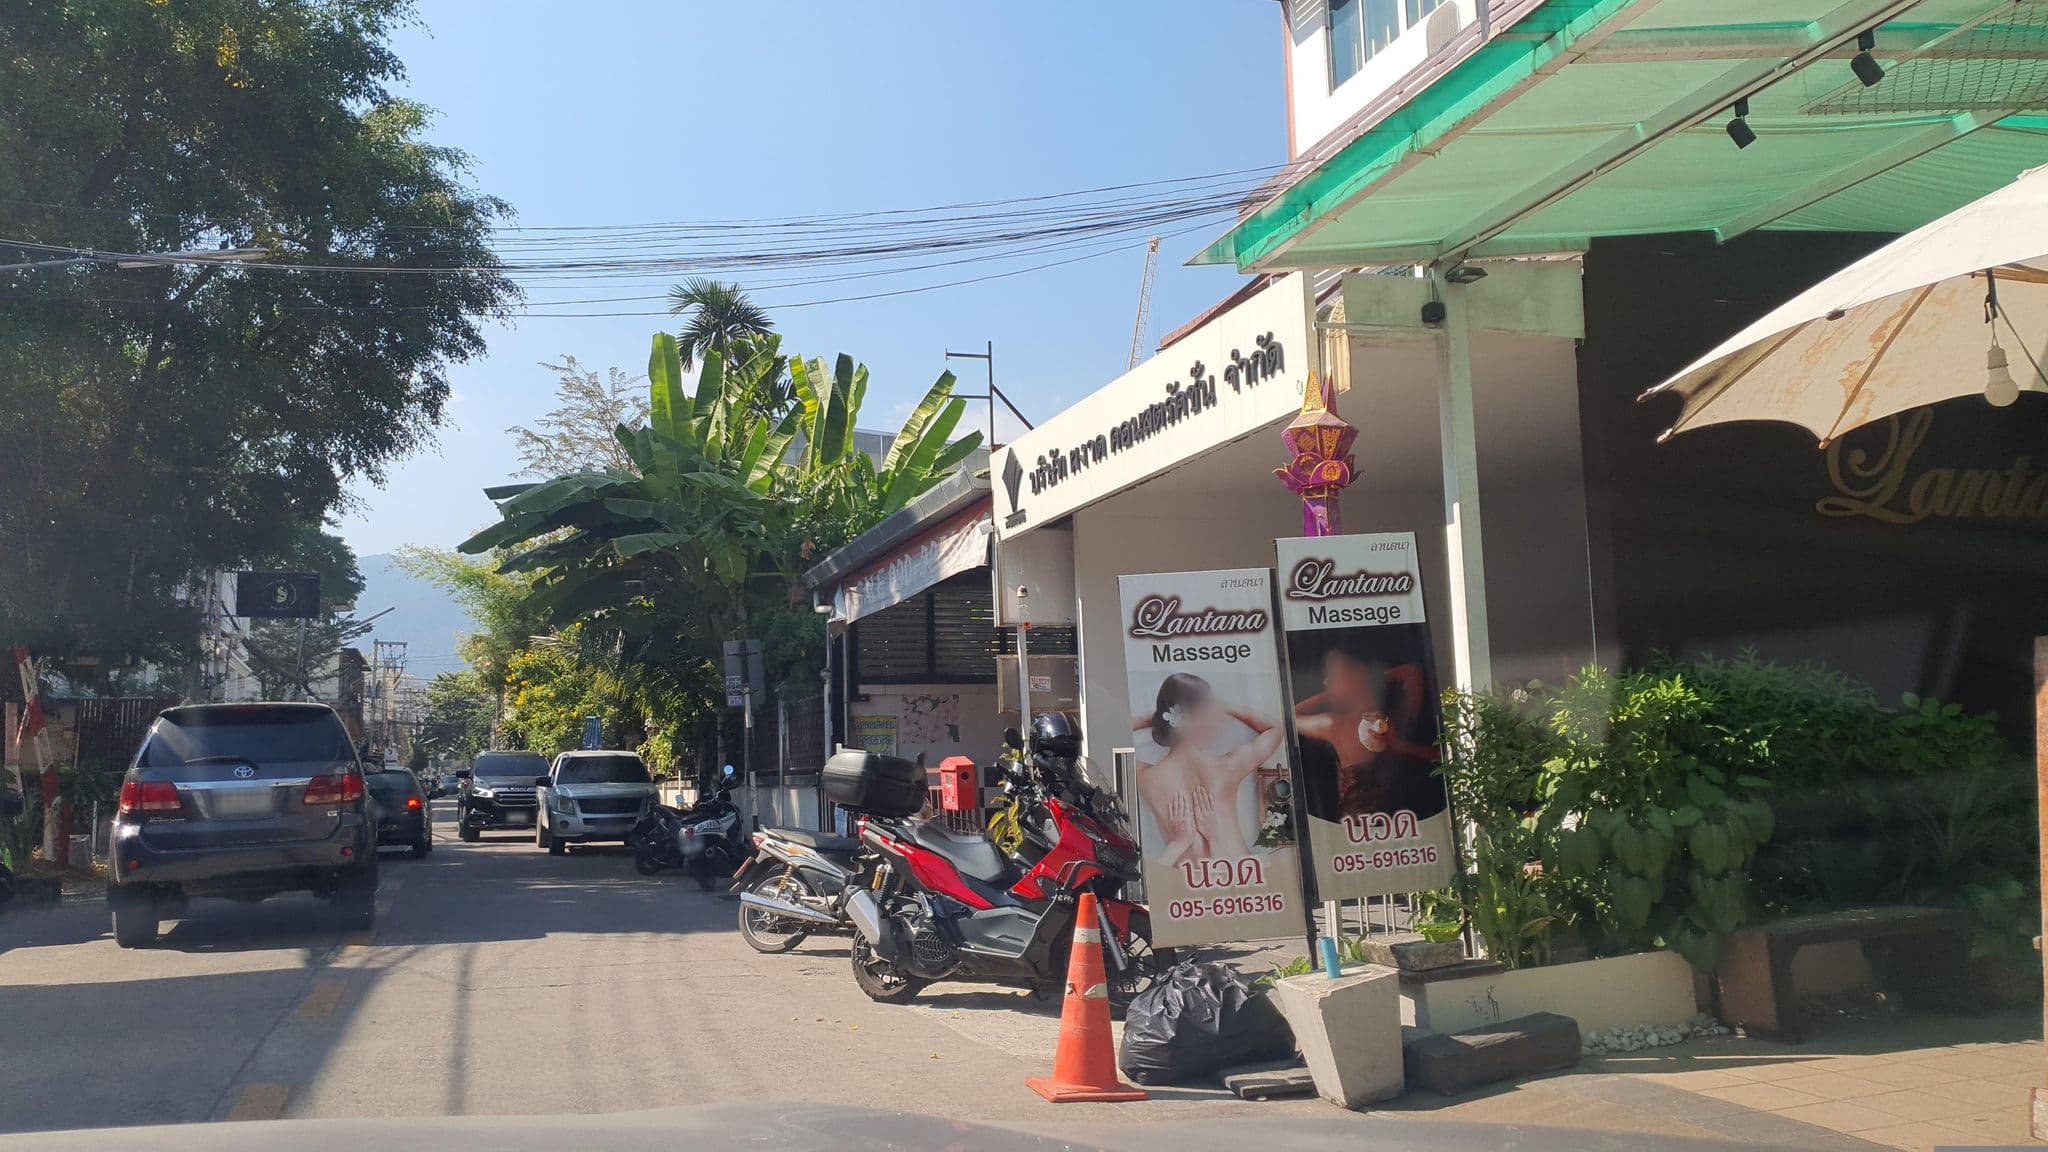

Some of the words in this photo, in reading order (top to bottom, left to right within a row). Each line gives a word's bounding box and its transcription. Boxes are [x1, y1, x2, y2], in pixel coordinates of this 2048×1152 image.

[1224, 331, 1285, 395] จำกัด
[1289, 560, 1413, 599] Lantana
[1132, 598, 1267, 637] Lantana
[1308, 605, 1401, 625] Massage
[1152, 643, 1252, 664] Massage
[1343, 811, 1419, 843] นวด
[1181, 857, 1265, 889] นวด
[1333, 846, 1437, 873] 095-6916316
[1169, 894, 1284, 919] 095-6916316
